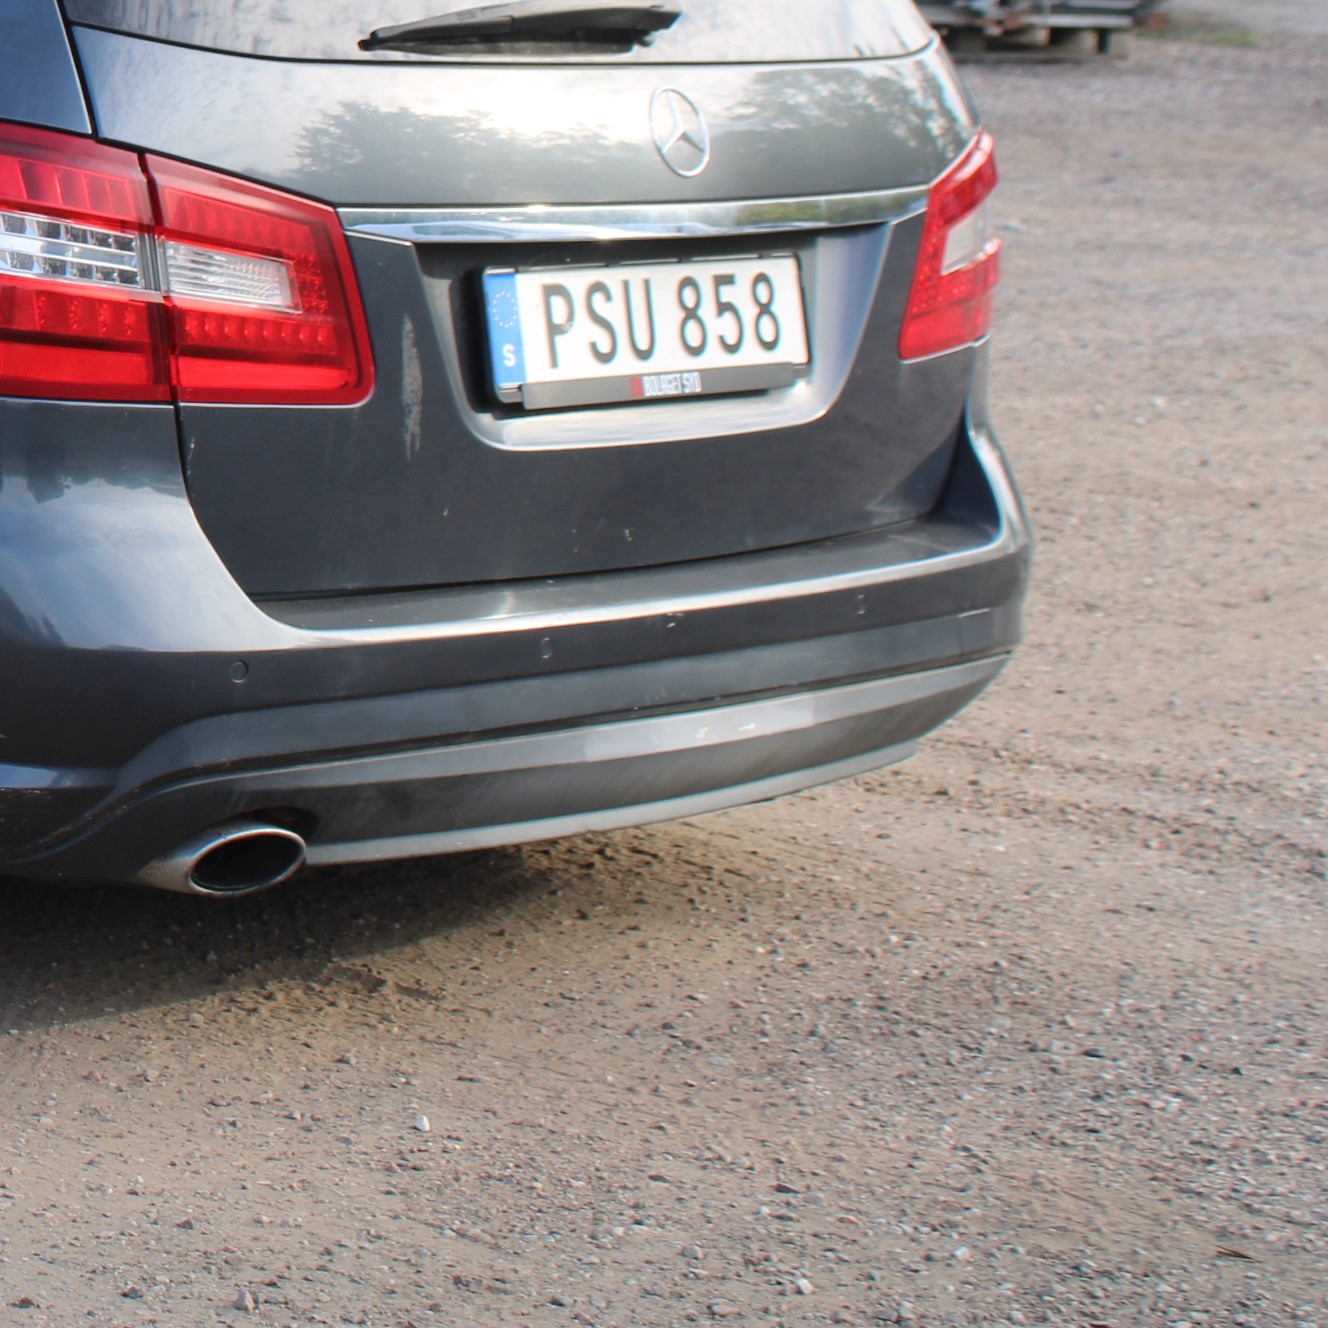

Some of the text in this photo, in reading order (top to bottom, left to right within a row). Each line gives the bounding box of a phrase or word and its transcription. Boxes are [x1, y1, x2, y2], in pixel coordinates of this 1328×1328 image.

[541, 272, 781, 369] PSU 858
[502, 343, 516, 368] S
